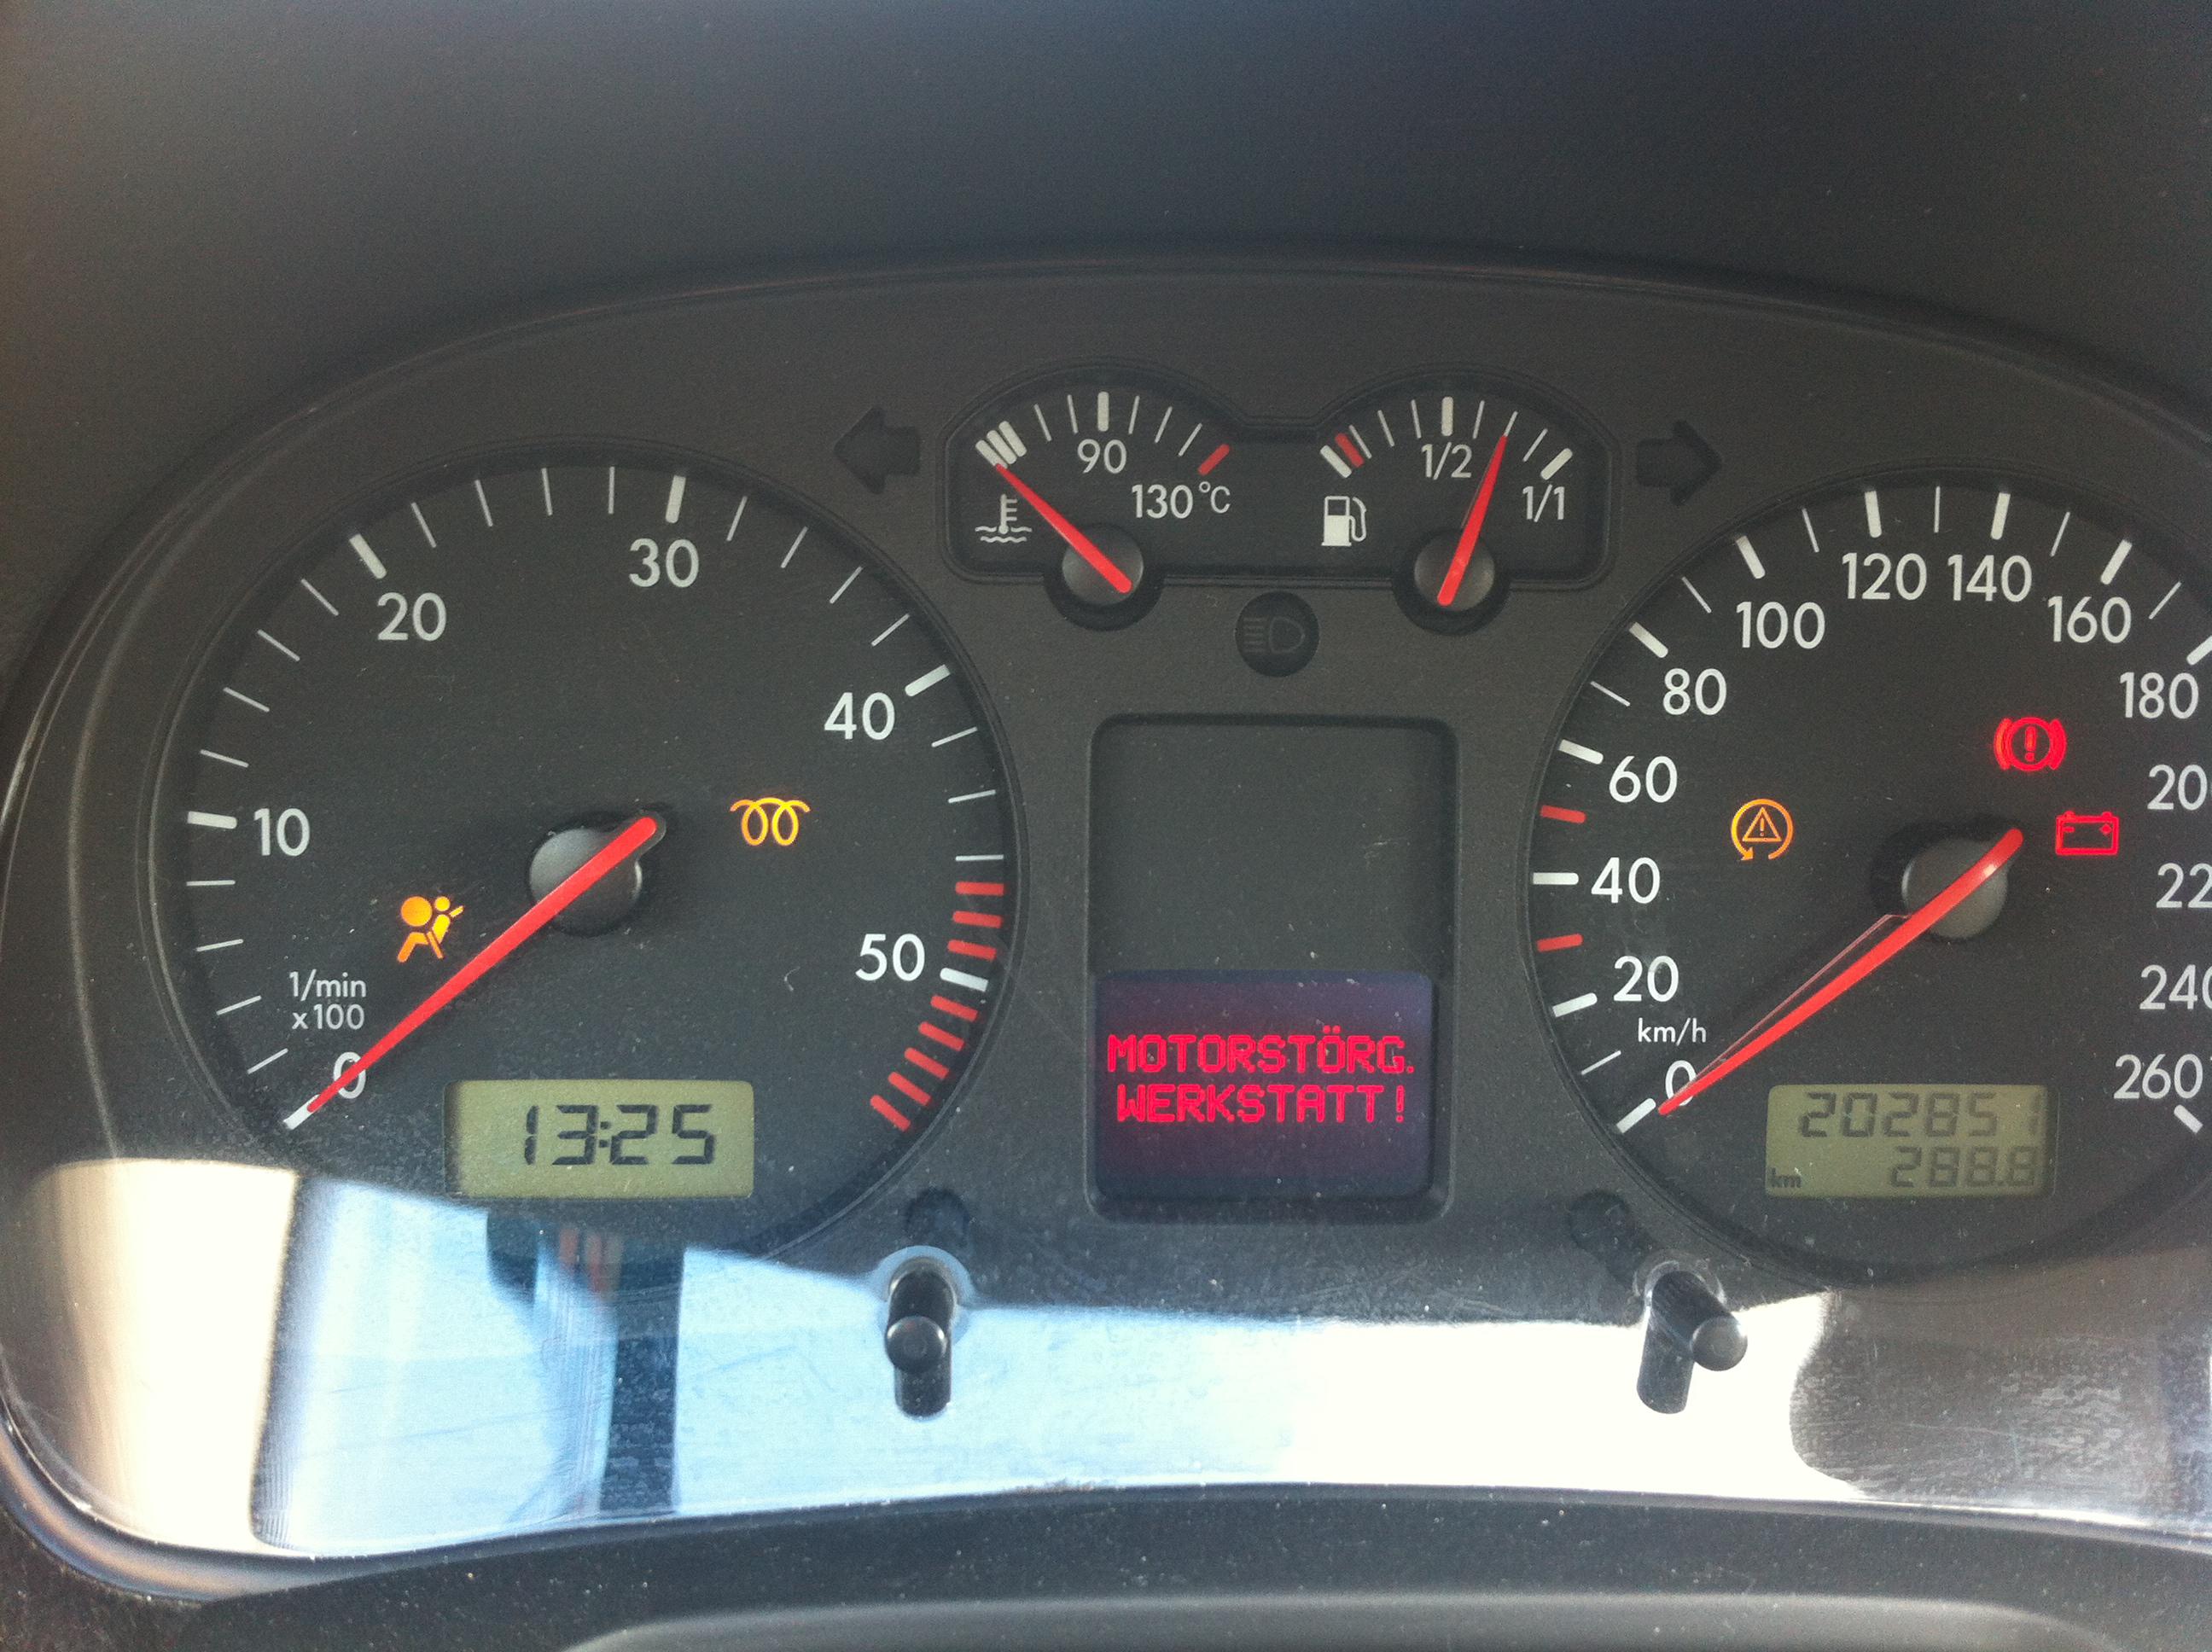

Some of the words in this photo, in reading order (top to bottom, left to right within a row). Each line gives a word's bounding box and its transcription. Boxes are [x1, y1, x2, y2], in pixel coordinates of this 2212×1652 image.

[1077, 439, 1127, 474] 90
[1421, 441, 1472, 480] 1/2
[1522, 484, 1565, 523] 1/1
[629, 538, 699, 588] 30
[1842, 552, 1928, 601] 120
[1947, 554, 2033, 602] 140
[377, 591, 446, 642] 20
[1736, 601, 1825, 649] 100
[2047, 596, 2132, 644] 160
[1662, 667, 1727, 716] 80
[2120, 672, 2199, 719] 180
[824, 691, 895, 741] 40
[1609, 755, 1678, 803] 60
[253, 808, 310, 857] 10
[1591, 857, 1661, 905] 40
[855, 933, 925, 982] 50
[1613, 955, 1679, 1003] 20
[289, 969, 366, 1002] 1/min
[1108, 1025, 1415, 1073] MOTORSTÖRG.
[1638, 1017, 1707, 1046] km/h
[332, 1051, 366, 1099] 0
[1665, 1060, 1698, 1107] 0
[2113, 1053, 2203, 1100] 260
[523, 1103, 717, 1166] 13:25
[1769, 1167, 1802, 1189] km
[1889, 1146, 2038, 1189] 288.8
